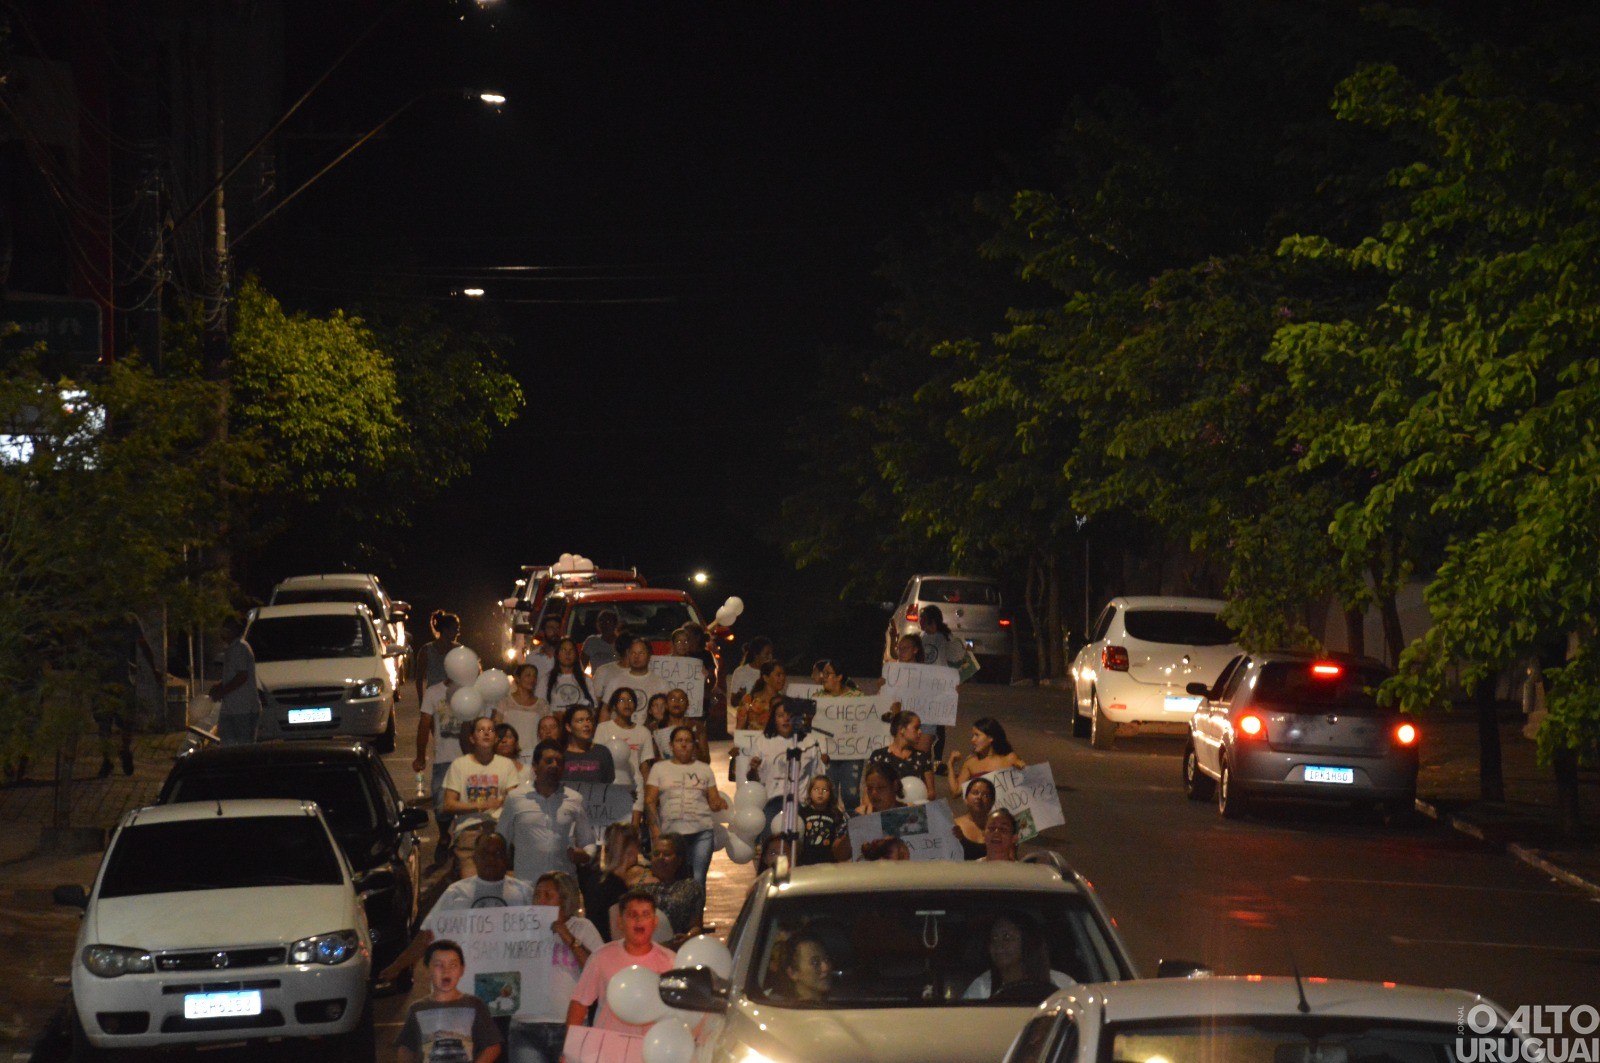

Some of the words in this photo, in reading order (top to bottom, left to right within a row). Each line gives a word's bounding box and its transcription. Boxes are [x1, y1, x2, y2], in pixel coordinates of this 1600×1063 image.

[887, 665, 923, 688] UTI
[825, 704, 879, 721] CHEGA
[843, 724, 858, 734] DE
[437, 913, 494, 934] QUANTOS
[503, 908, 541, 933] BEBÊS
